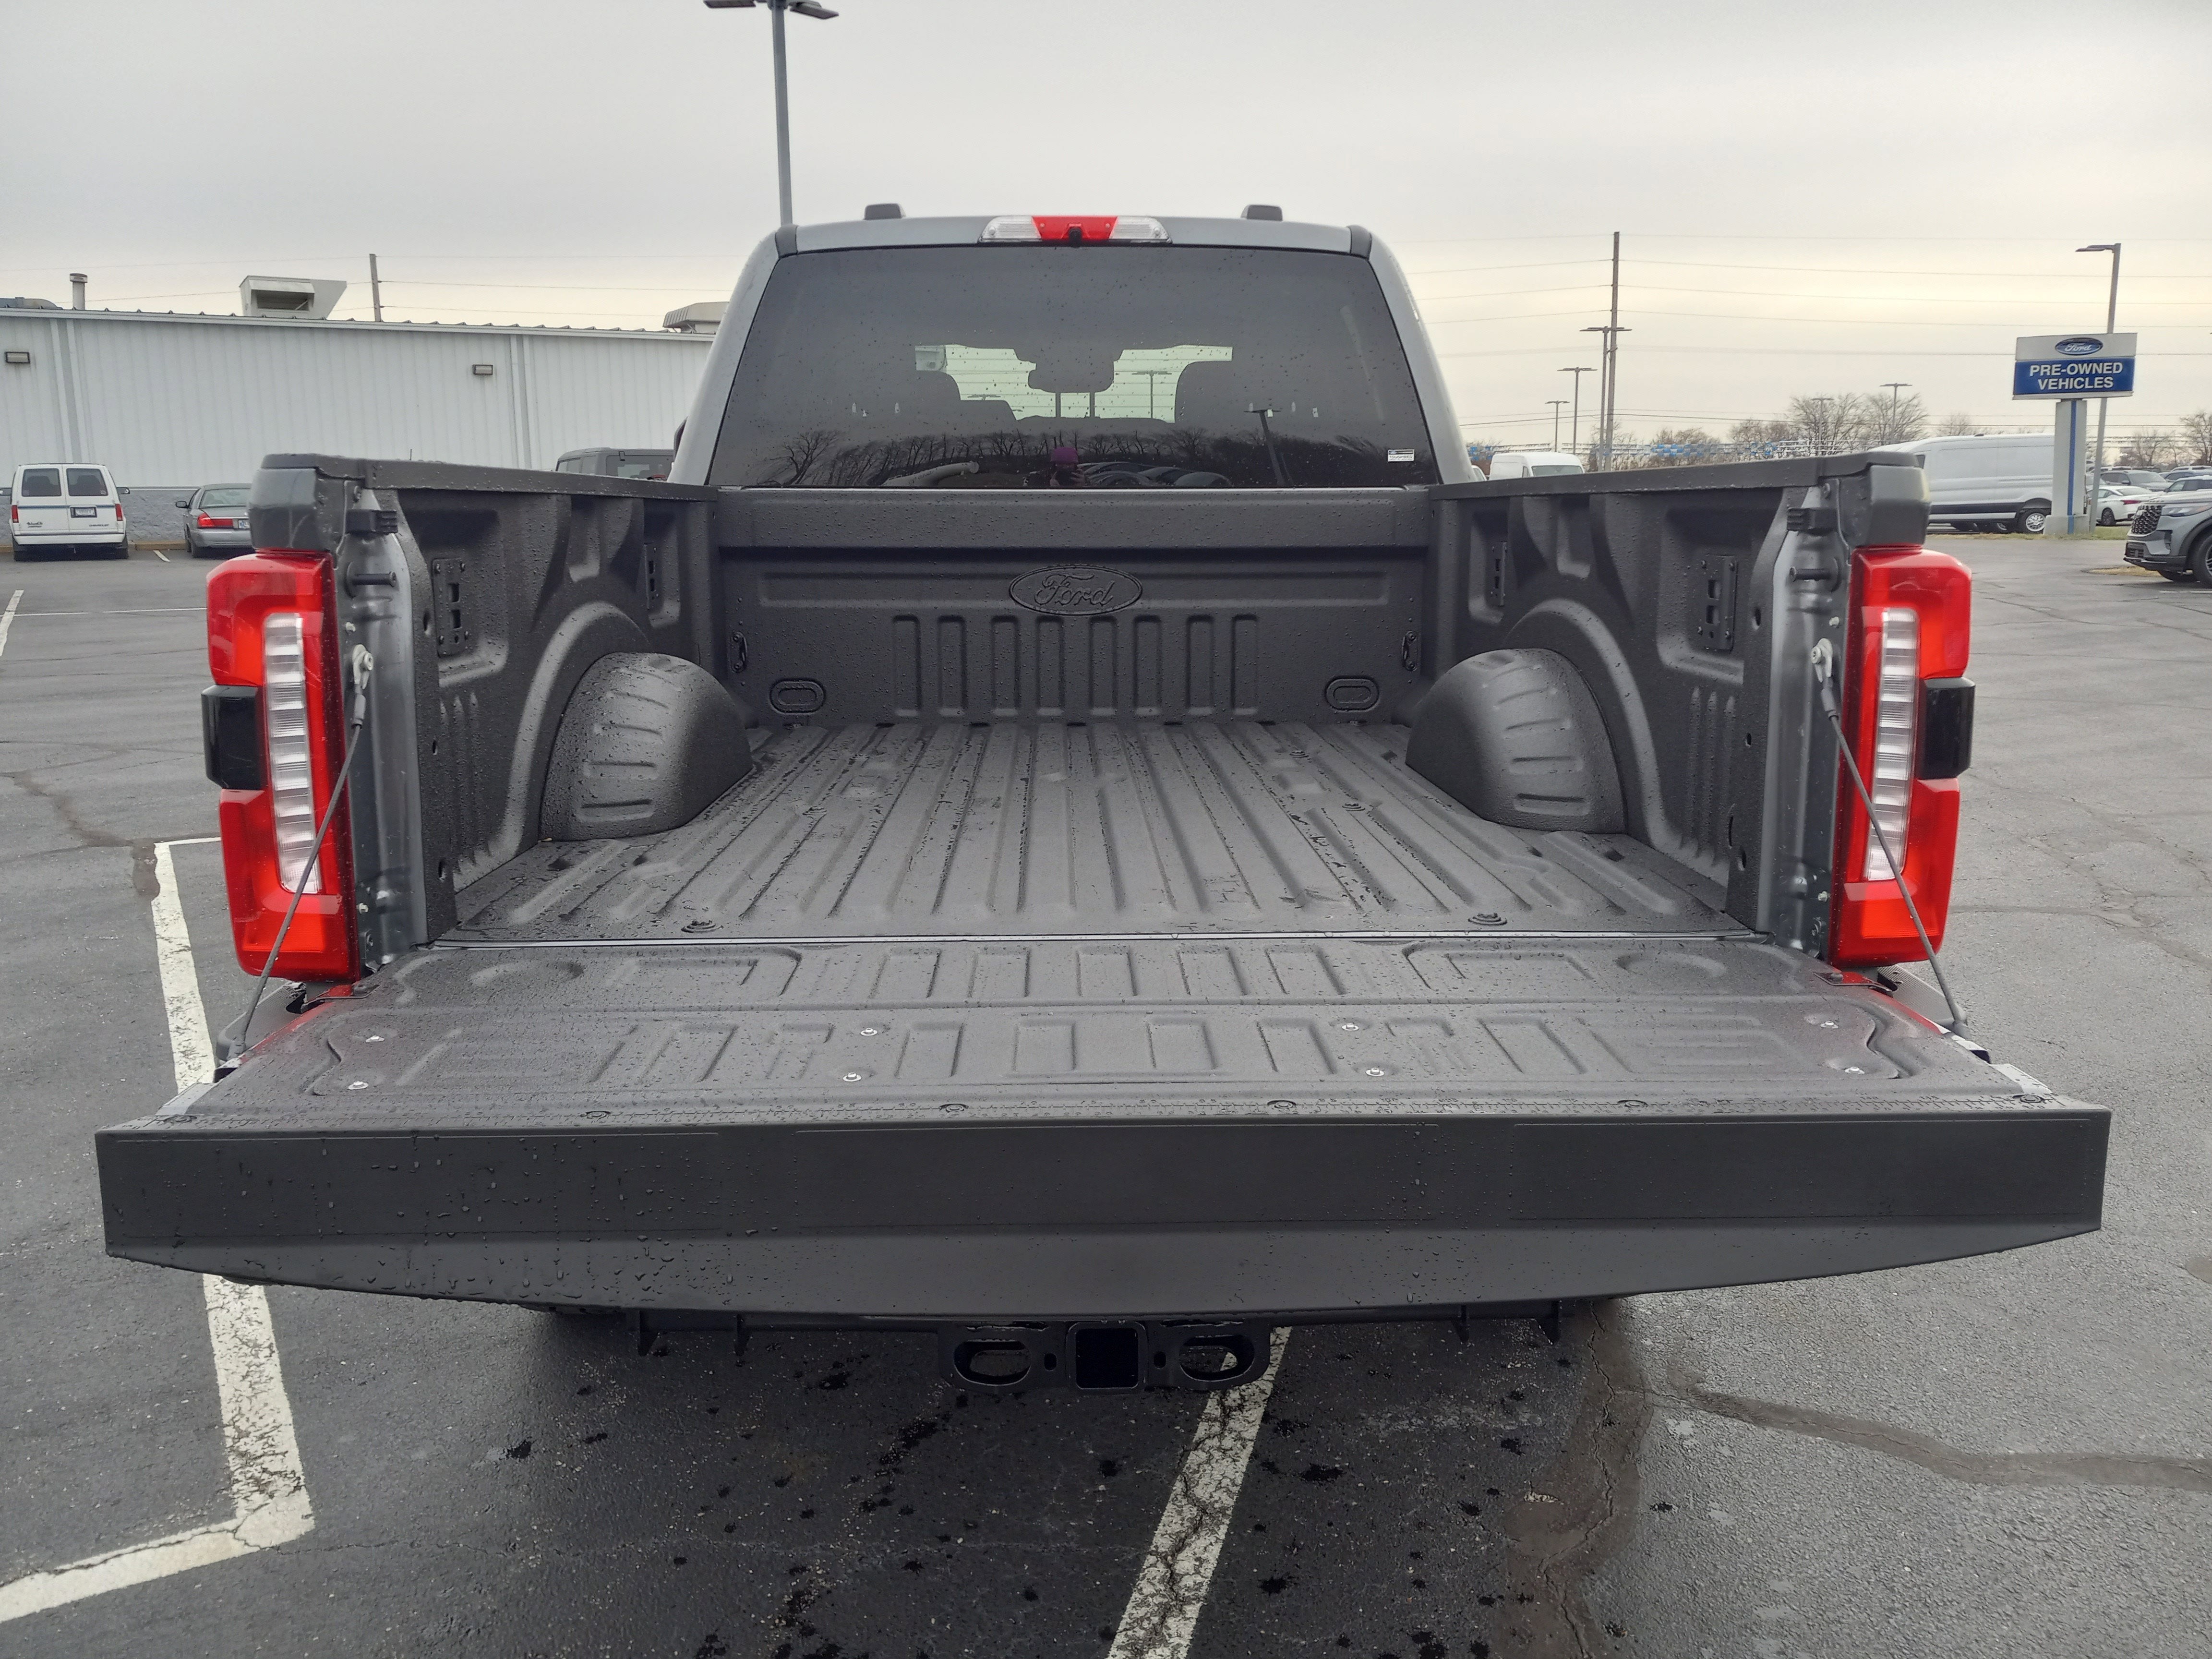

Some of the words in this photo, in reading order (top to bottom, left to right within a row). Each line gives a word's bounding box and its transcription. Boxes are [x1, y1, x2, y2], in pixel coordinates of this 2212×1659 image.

[2030, 362, 2123, 377] PRE-OWNED
[2038, 376, 2114, 390] VEHICLES
[1034, 573, 1115, 606] Ford
